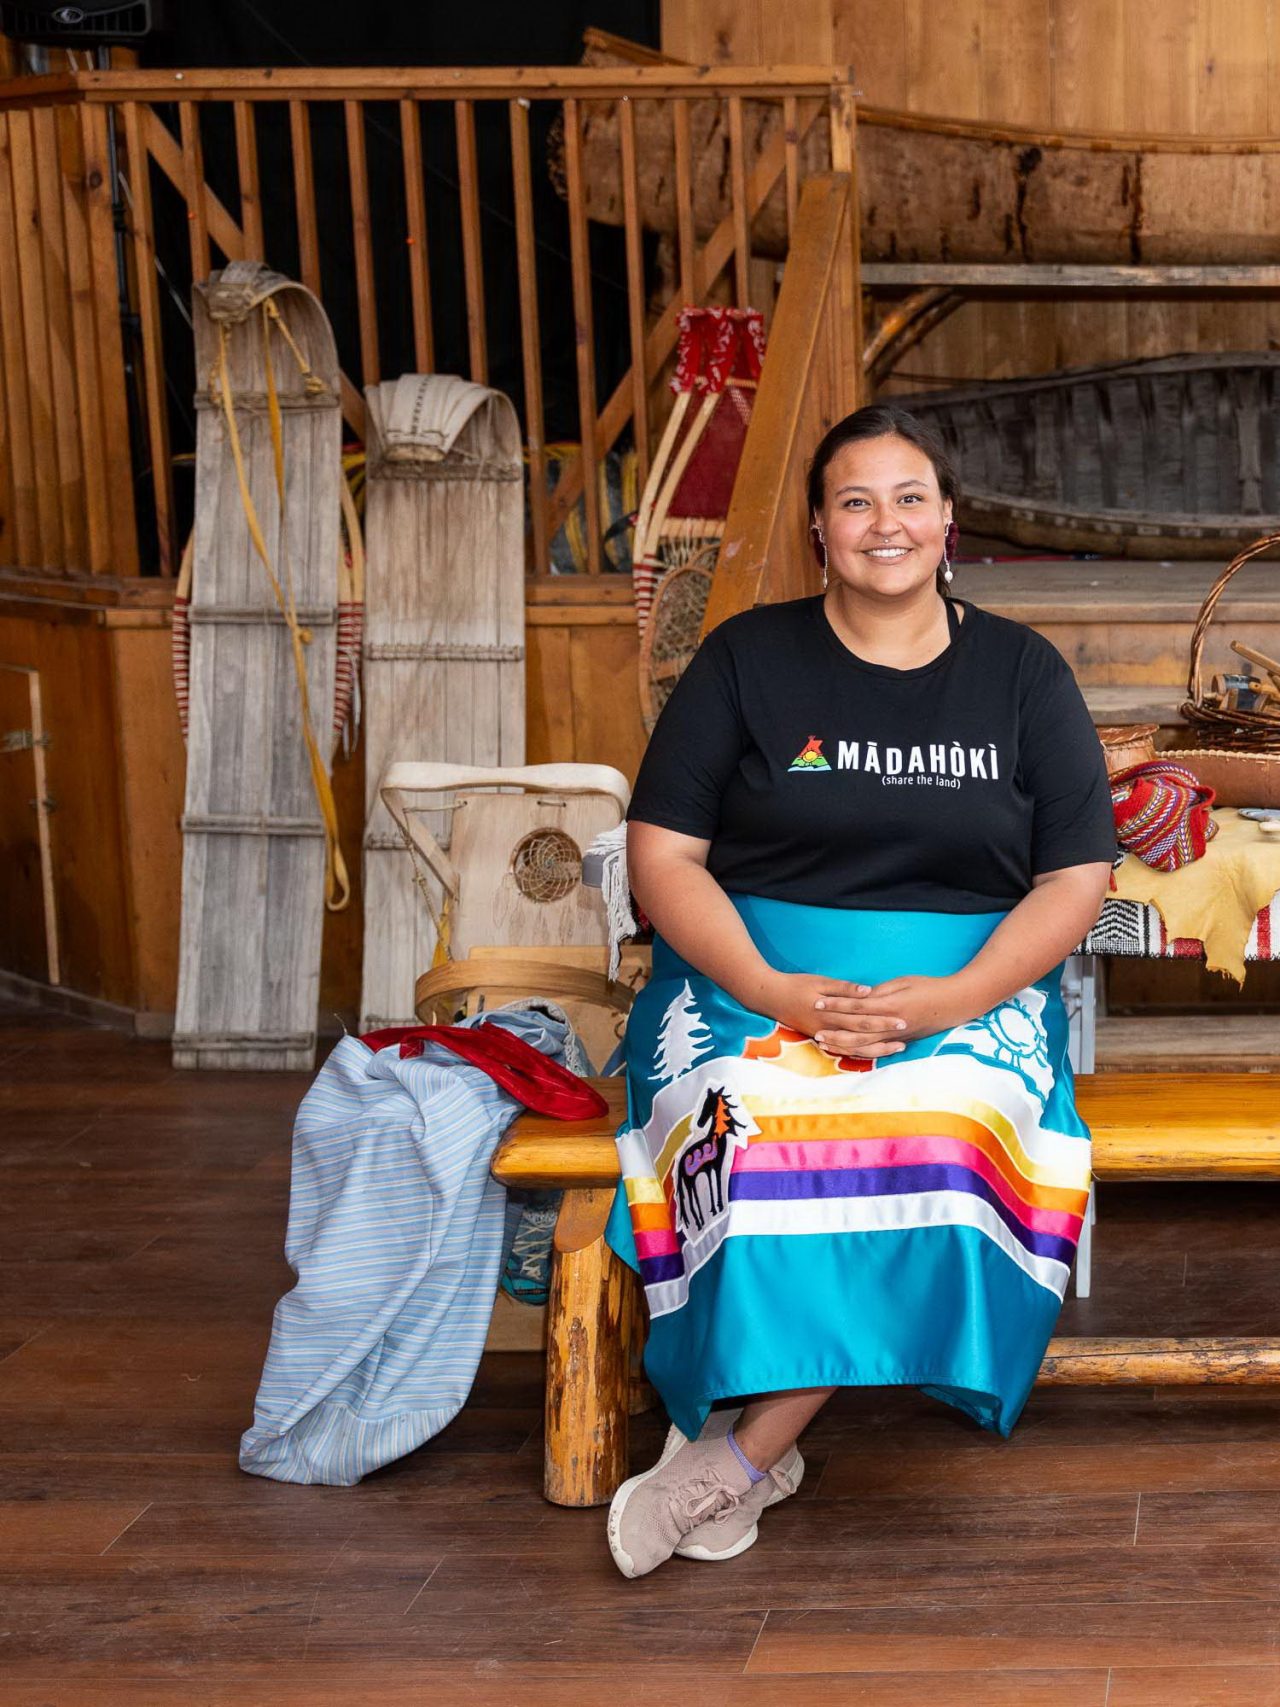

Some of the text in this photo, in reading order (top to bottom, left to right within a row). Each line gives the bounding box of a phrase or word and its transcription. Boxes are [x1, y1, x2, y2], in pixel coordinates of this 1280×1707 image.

[838, 740, 999, 780] MĀDAHÒKÌ
[881, 774, 961, 790] (share the land)
